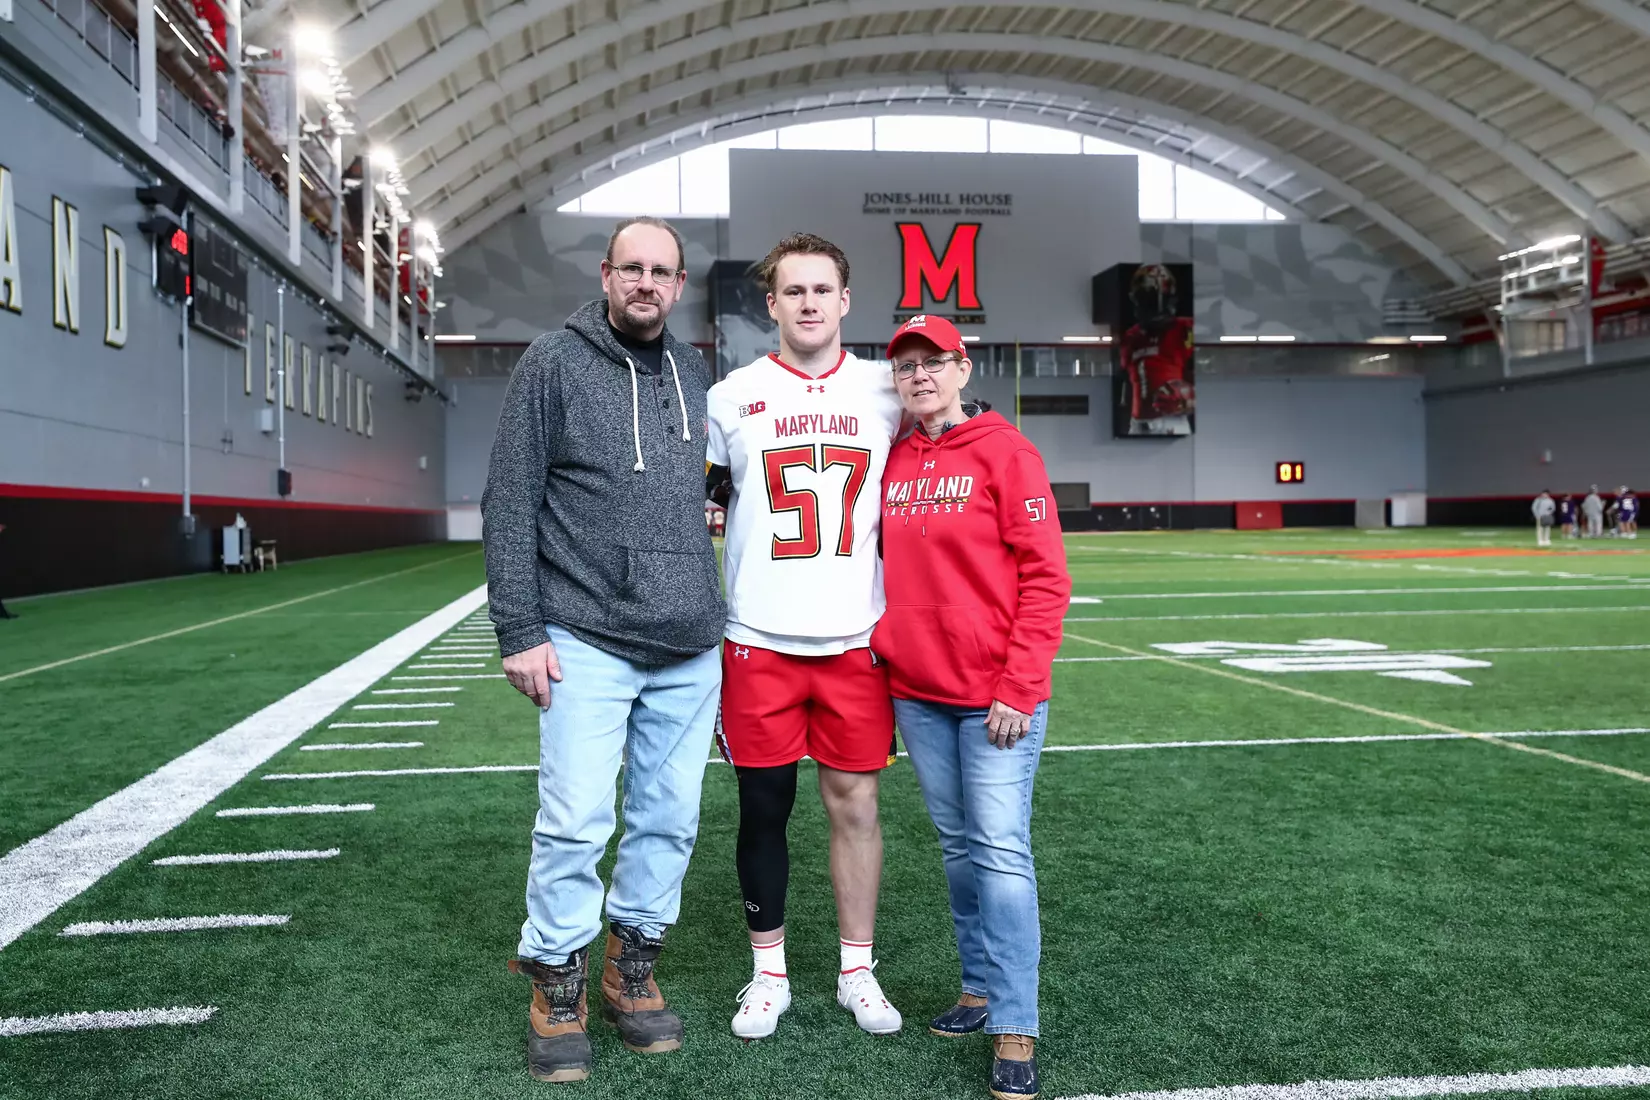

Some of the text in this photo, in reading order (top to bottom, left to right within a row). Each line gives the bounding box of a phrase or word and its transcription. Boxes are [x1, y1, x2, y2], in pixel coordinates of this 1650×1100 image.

[862, 192, 1013, 207] JONES-HILL HOUSE
[862, 206, 1012, 217] HOME OF MARYLAND FOOTBALL
[894, 222, 984, 311] M
[774, 414, 859, 438] MARYLAND
[762, 443, 872, 561] 57
[1024, 497, 1046, 522] 57
